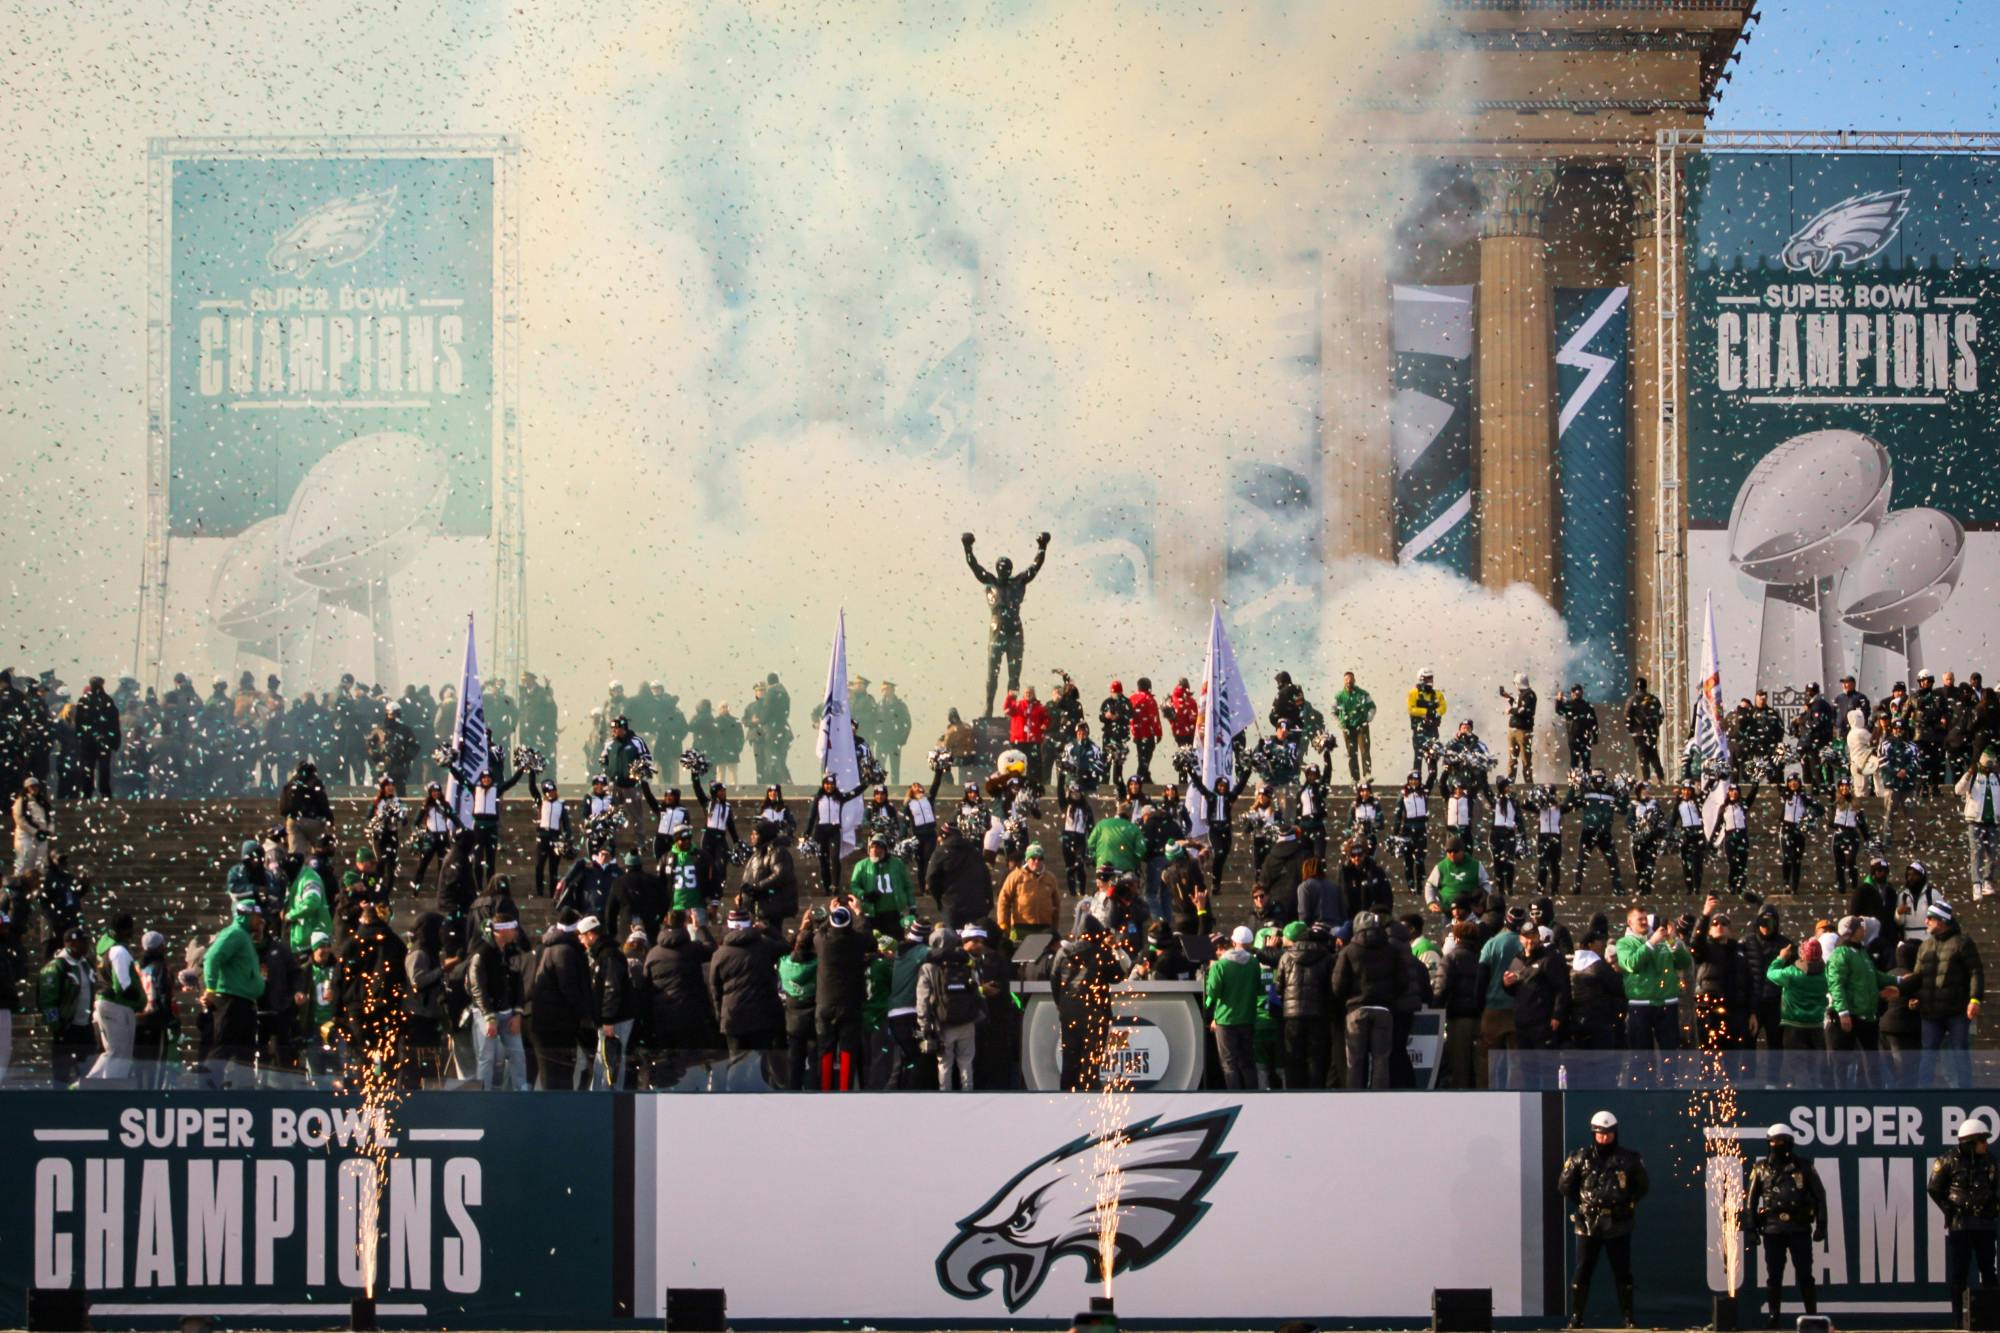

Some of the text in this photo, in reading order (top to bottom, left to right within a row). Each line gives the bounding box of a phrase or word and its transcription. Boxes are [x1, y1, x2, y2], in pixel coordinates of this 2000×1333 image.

[251, 287, 413, 311] SUPER BOWL
[1766, 285, 1928, 308] SUPER BOWL
[200, 315, 463, 396] CHAMPIONS
[1717, 312, 1978, 392] CHAMPIONS
[877, 873, 893, 894] 11
[120, 1108, 398, 1147] SUPER BOWL
[1789, 1106, 1924, 1145] SUPER
[35, 1157, 482, 1294] CHAMPIONS
